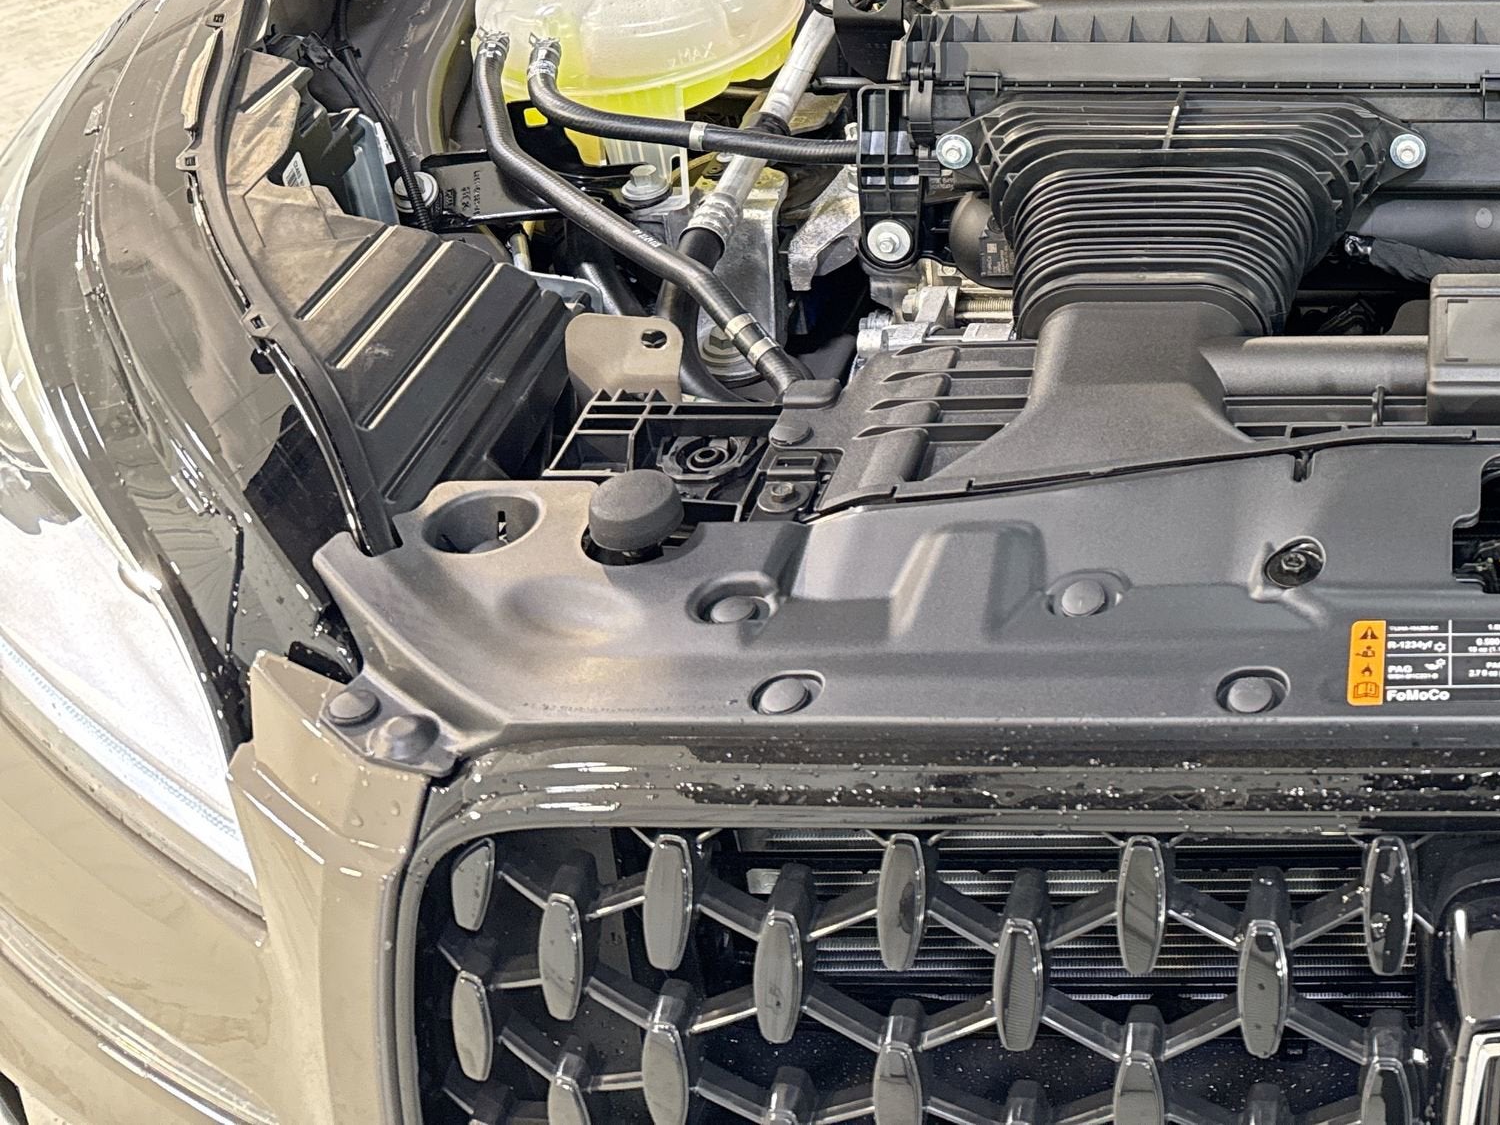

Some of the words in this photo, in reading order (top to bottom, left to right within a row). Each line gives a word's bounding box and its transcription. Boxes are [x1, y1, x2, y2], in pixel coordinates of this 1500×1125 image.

[677, 41, 717, 66] MAX
[1387, 640, 1433, 650] R-1234yf
[1387, 665, 1413, 673] PAG
[1386, 689, 1450, 701] FoMoCo
